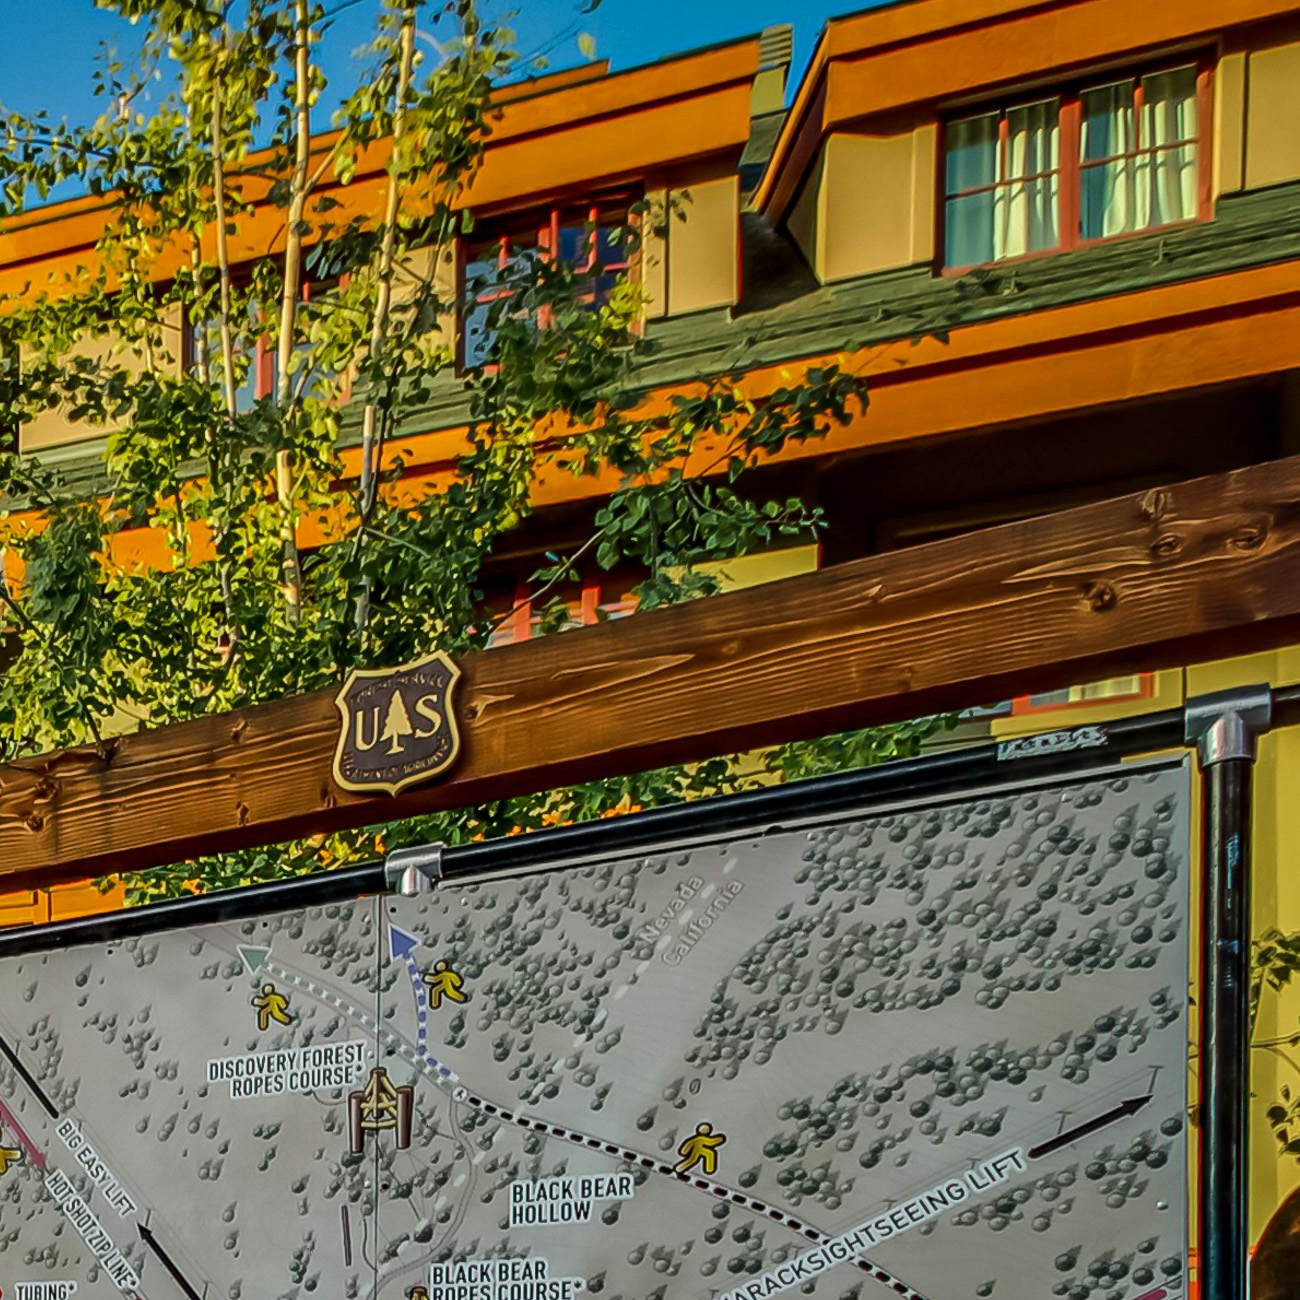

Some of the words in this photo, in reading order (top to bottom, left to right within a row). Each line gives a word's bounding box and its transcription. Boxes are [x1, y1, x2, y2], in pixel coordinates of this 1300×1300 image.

[640, 876, 704, 944] Nevada
[663, 879, 744, 965] California
[210, 1053, 297, 1081] DISCOVERY
[303, 1043, 365, 1068] FOREST
[232, 1074, 284, 1097] ROPES
[58, 1121, 82, 1149] BIG
[77, 1146, 112, 1184] EASY
[105, 1182, 136, 1217] LIFT
[968, 1151, 1023, 1190] LIFT
[512, 1179, 574, 1203] BLACK
[580, 1177, 631, 1198] BEAR
[48, 1171, 75, 1201] HOT
[66, 1197, 97, 1234] SHOT
[88, 1230, 112, 1253] ZIP
[512, 1201, 591, 1224] HOLLOW
[433, 1264, 491, 1284] BLACK
[498, 1261, 546, 1281] BEAR
